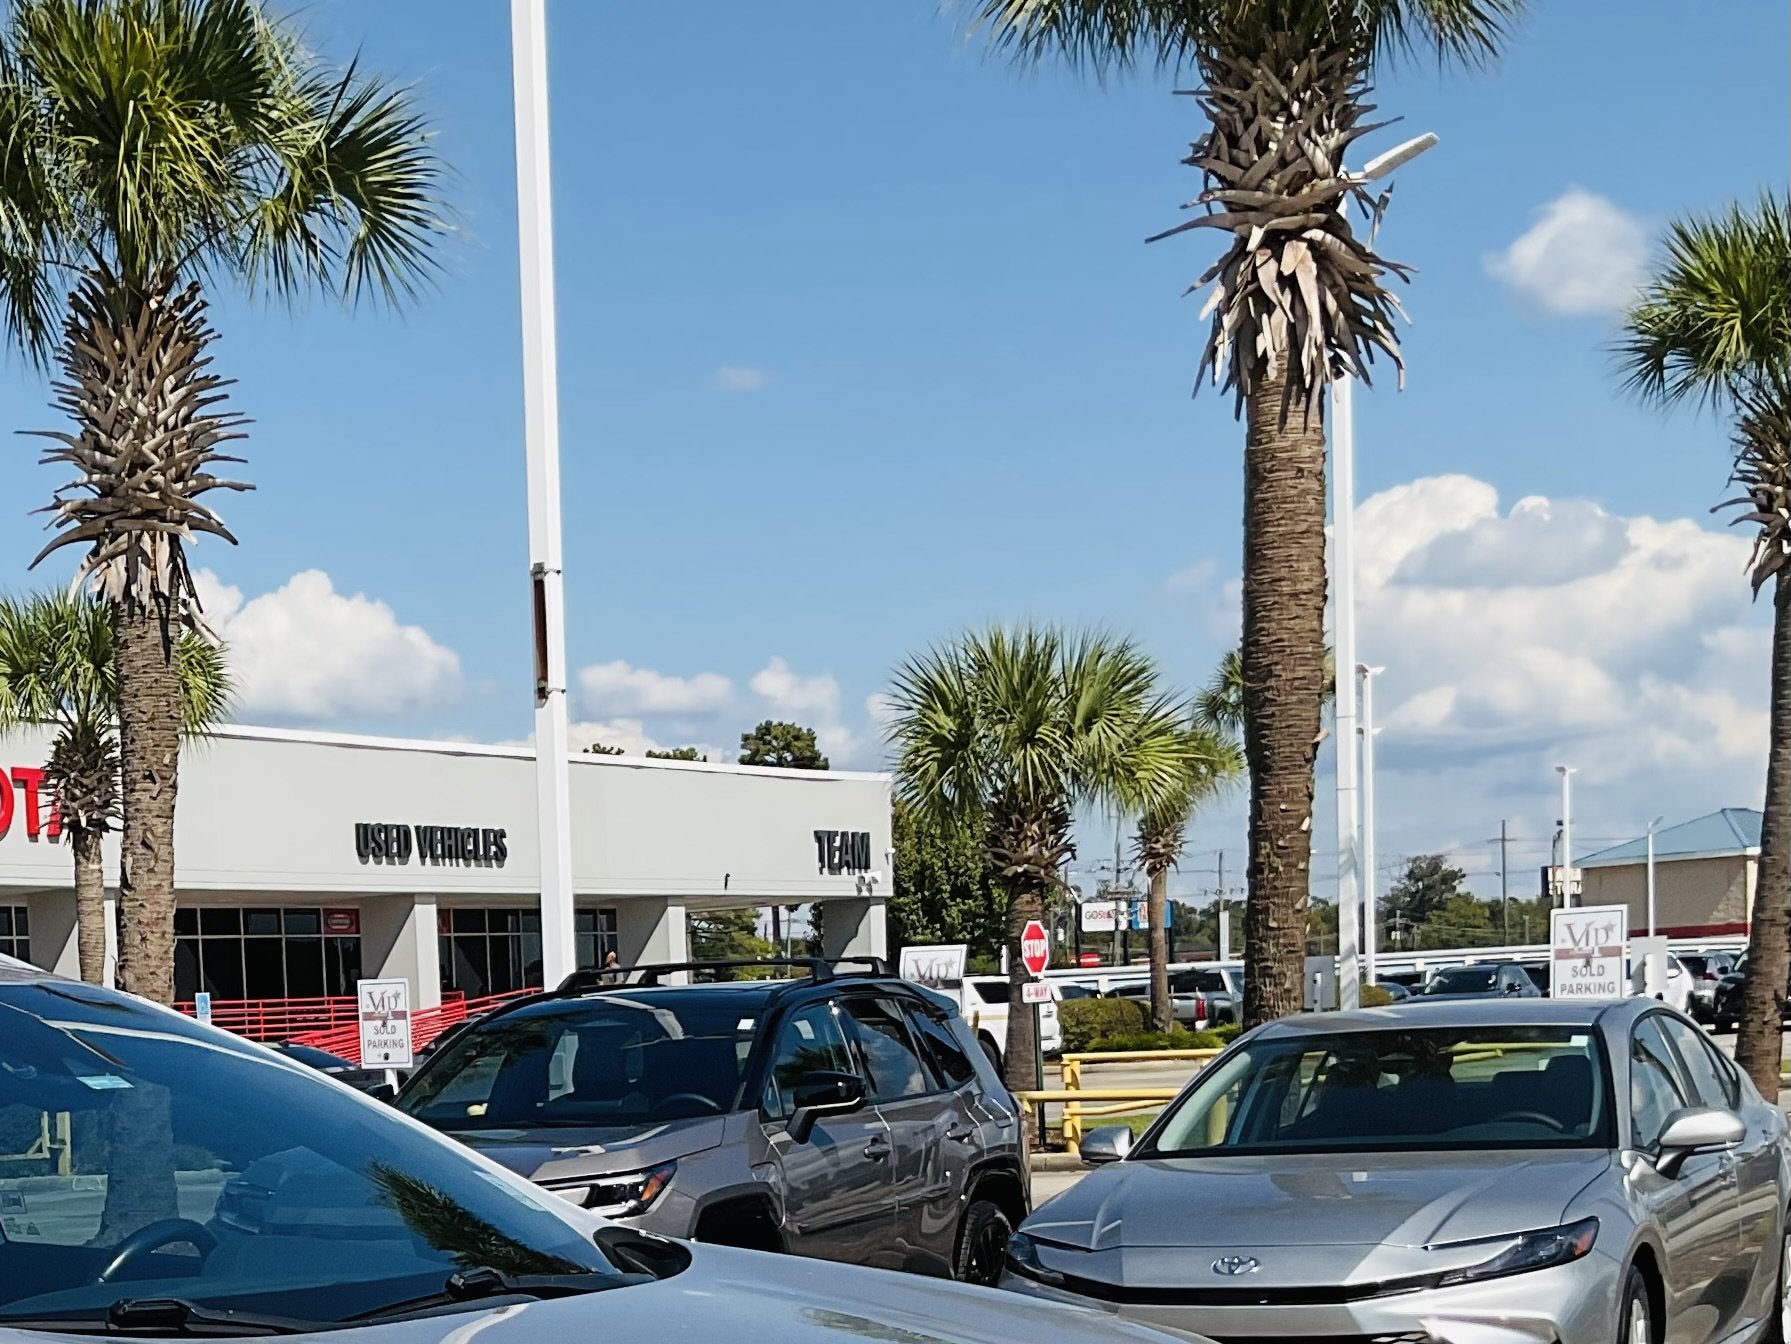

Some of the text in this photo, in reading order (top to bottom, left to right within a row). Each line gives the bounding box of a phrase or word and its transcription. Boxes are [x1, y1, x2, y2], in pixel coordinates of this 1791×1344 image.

[355, 823, 507, 863] USED VEHICLES
[813, 830, 871, 870] TEAM
[1024, 938, 1047, 958] STOP
[1571, 964, 1605, 978] SOLD
[1559, 981, 1616, 996] PARKING
[373, 1024, 397, 1035] SOLD
[367, 1039, 405, 1049] PARKING
